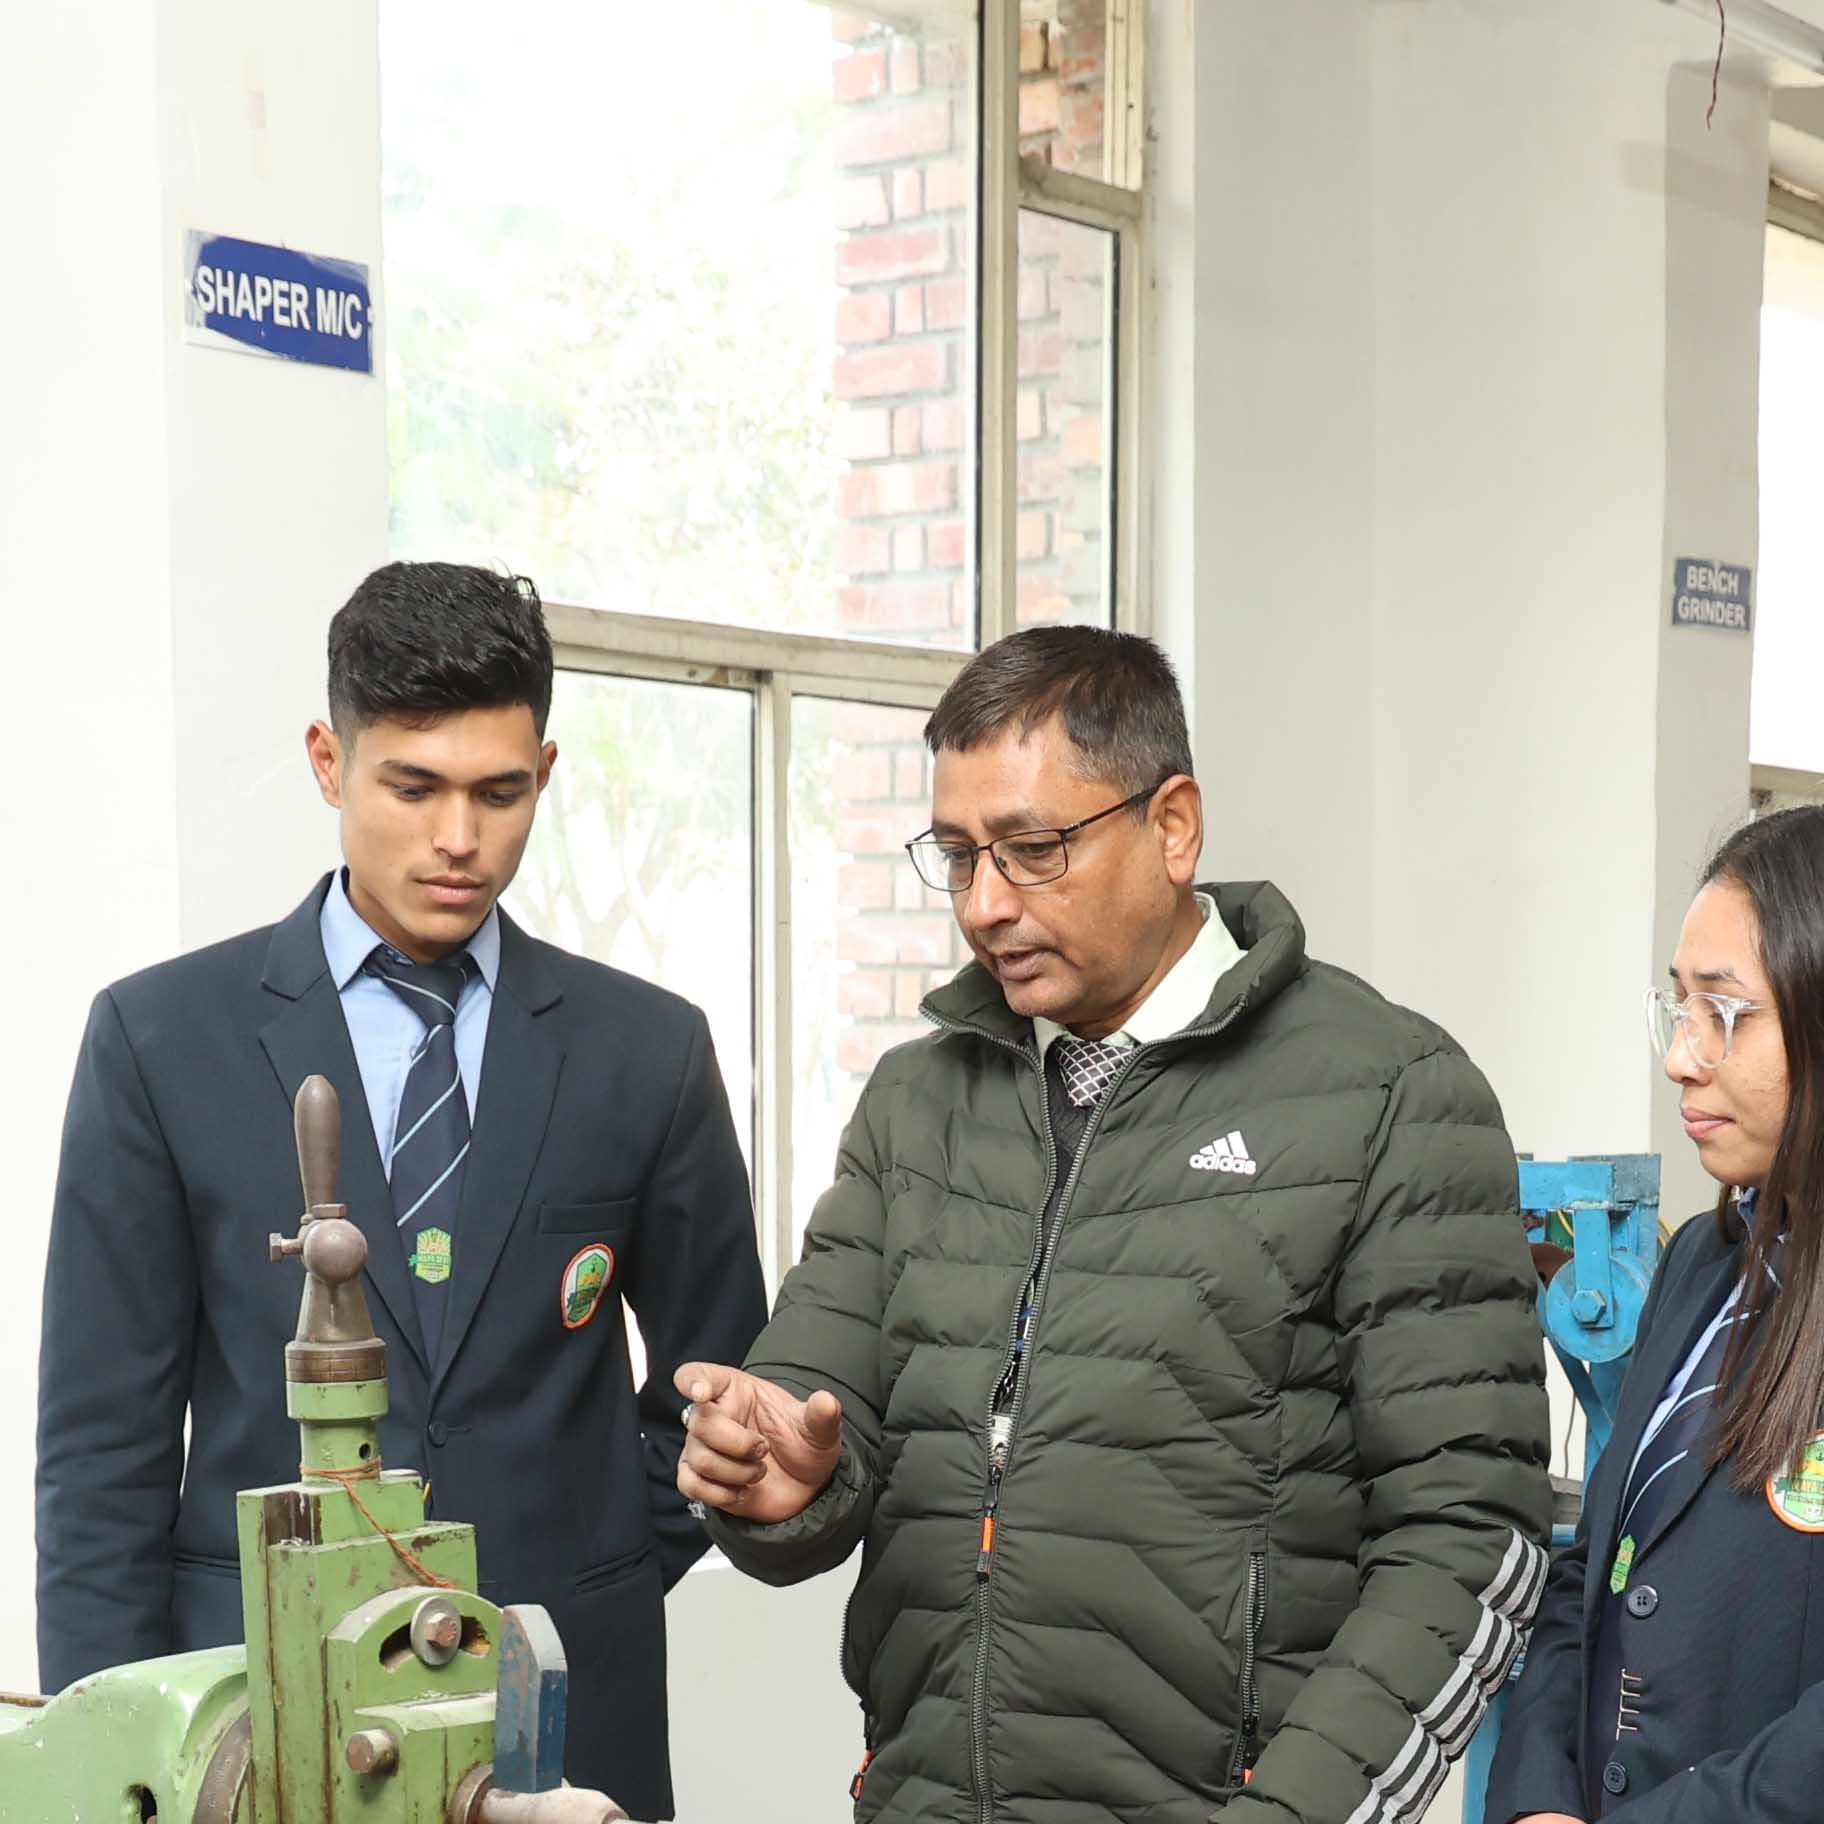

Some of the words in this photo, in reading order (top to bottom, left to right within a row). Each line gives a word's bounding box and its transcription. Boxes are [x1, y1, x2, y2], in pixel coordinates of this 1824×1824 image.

[196, 265, 311, 331] SHAPER
[1686, 565, 1739, 596] BENCH
[1678, 596, 1746, 628] GRINDER
[1189, 1153, 1256, 1175] adidas
